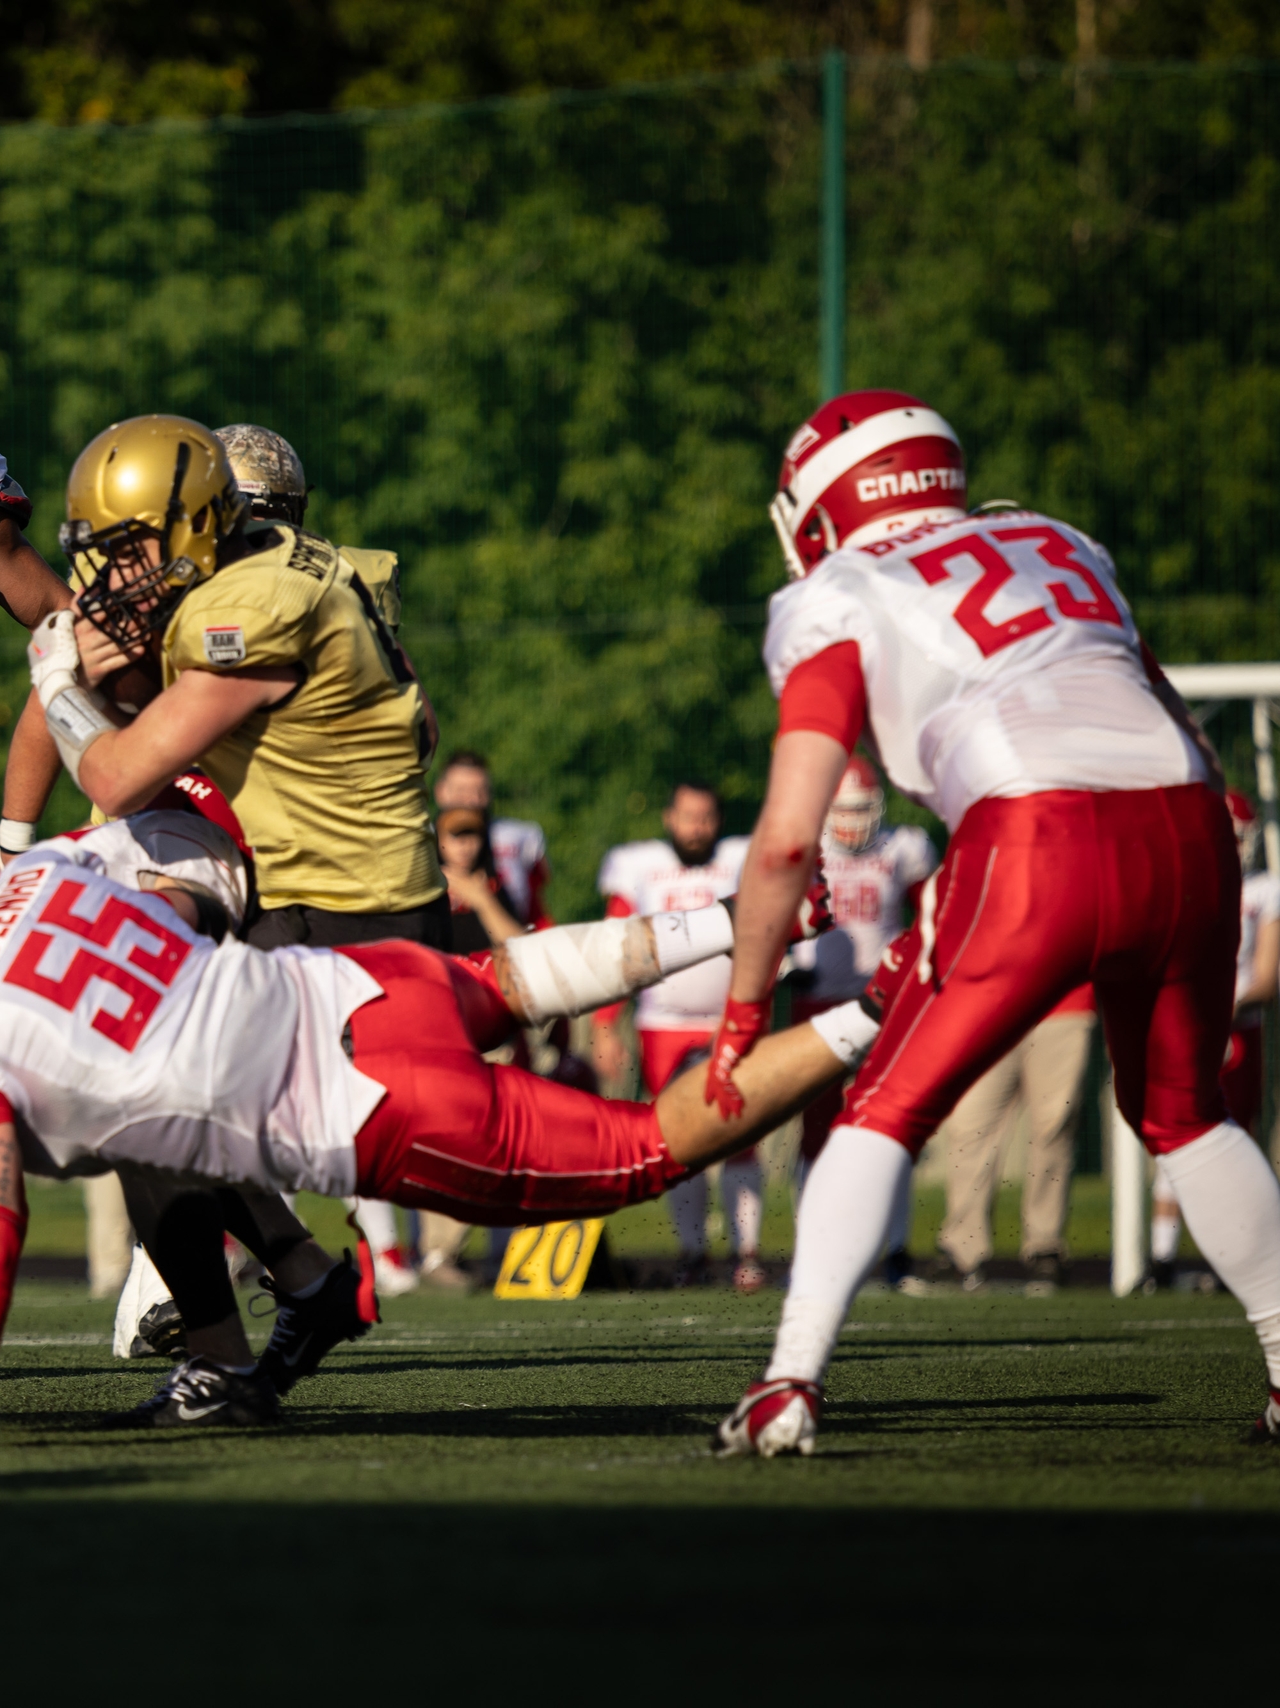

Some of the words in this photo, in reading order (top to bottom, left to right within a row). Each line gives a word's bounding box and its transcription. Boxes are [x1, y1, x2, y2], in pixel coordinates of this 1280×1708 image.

[908, 524, 1124, 659] 23
[3, 879, 193, 1054] 55
[508, 1219, 585, 1288] 20
